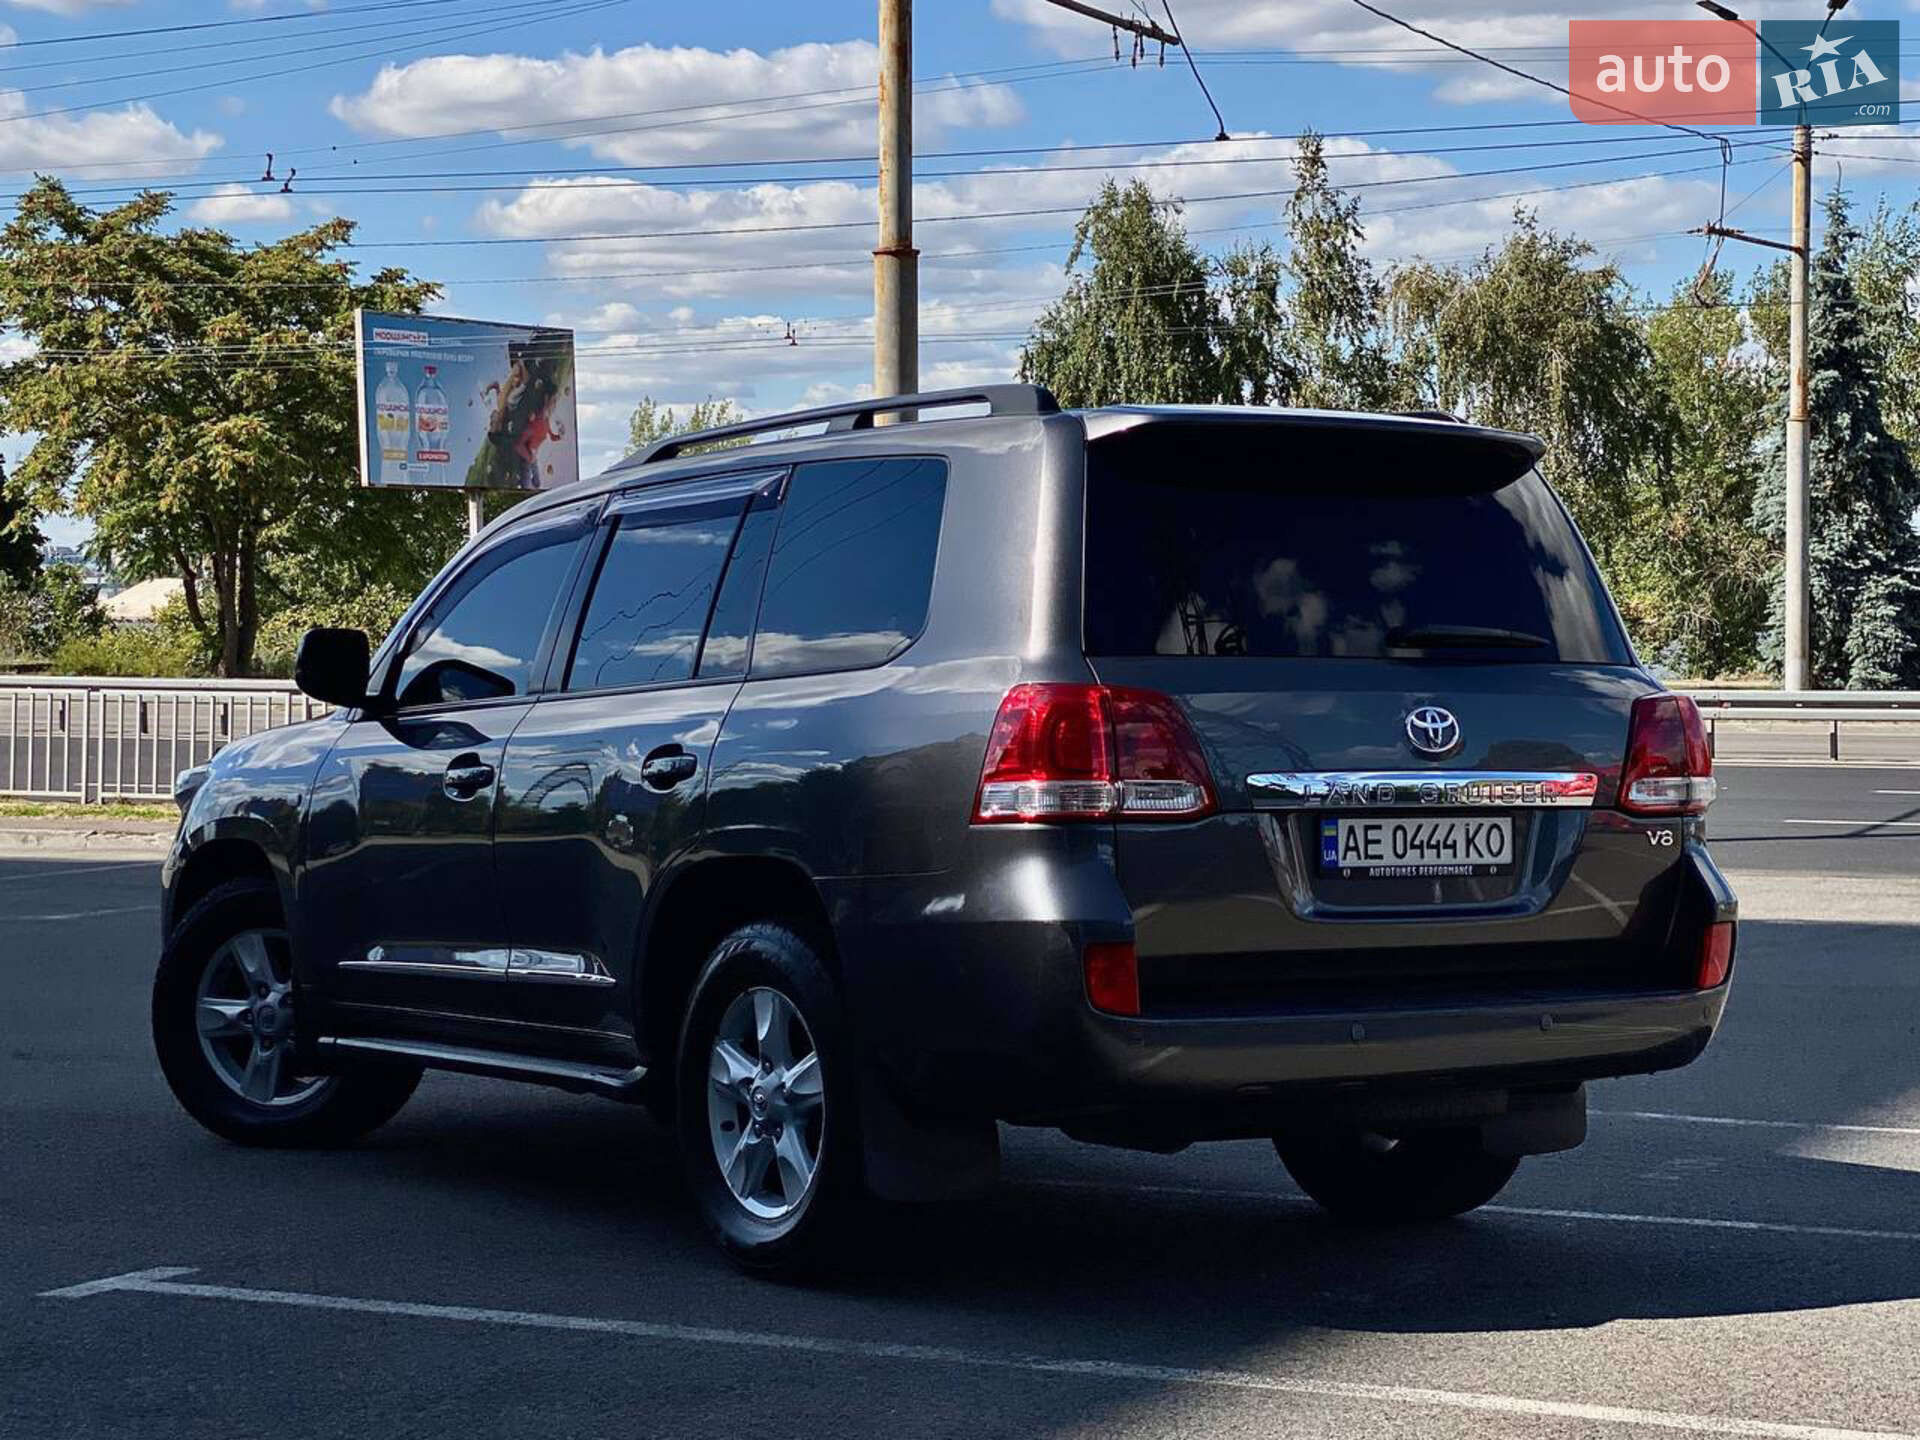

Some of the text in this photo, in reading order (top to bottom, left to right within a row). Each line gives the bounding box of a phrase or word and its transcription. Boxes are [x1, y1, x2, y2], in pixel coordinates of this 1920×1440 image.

[1303, 782, 1559, 807] LAND CRUISER
[1342, 823, 1505, 861] AE 0444 KO
[1646, 829, 1673, 846] V8
[1323, 850, 1337, 862] UA
